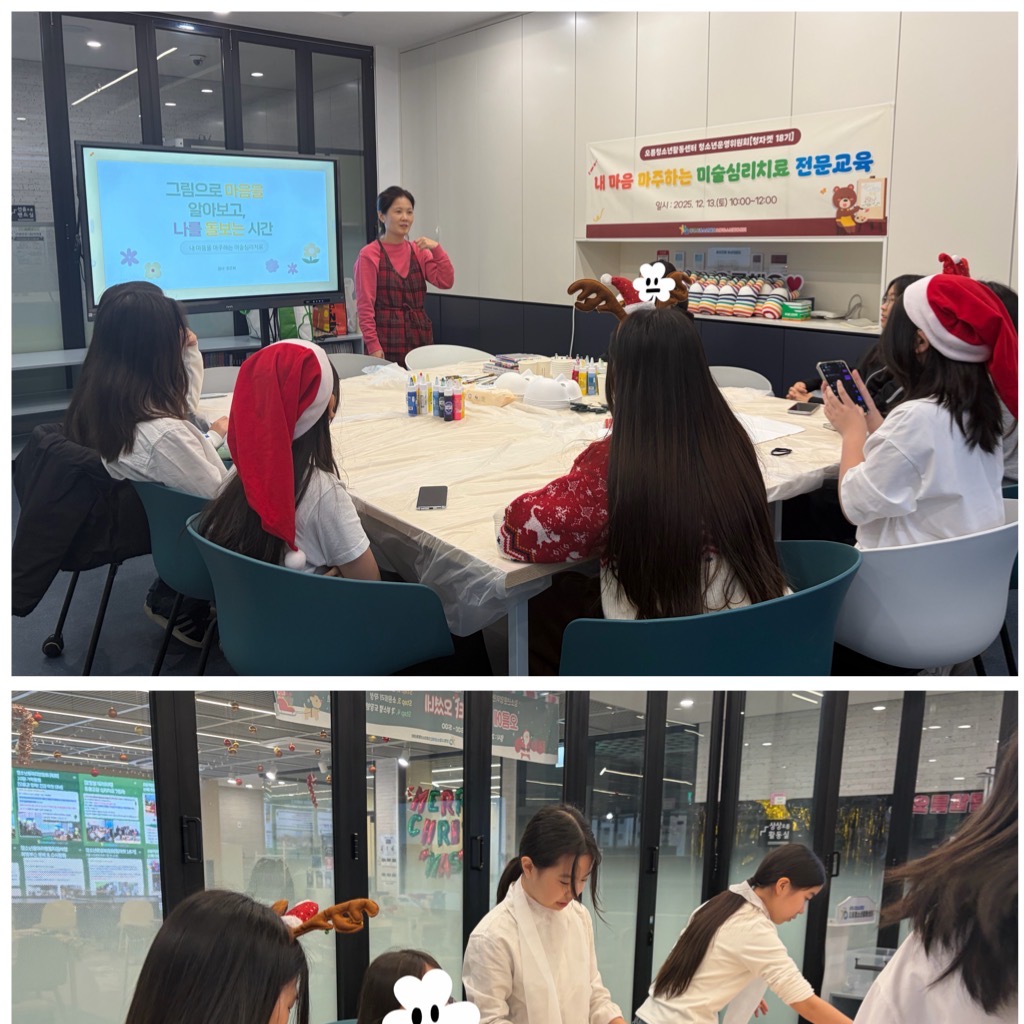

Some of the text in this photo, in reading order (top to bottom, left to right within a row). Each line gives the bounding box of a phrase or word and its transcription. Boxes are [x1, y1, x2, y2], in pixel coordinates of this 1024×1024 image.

[594, 151, 874, 191] 내 마음 마주하는 미술심리치료 전문교육
[166, 182, 263, 199] 그림으로 마음을
[188, 202, 246, 219] 알아보고,
[656, 200, 668, 211] 일시
[674, 200, 693, 209] 2025.
[695, 199, 705, 209] 12.
[173, 221, 273, 237] 나를 돌보는 시간
